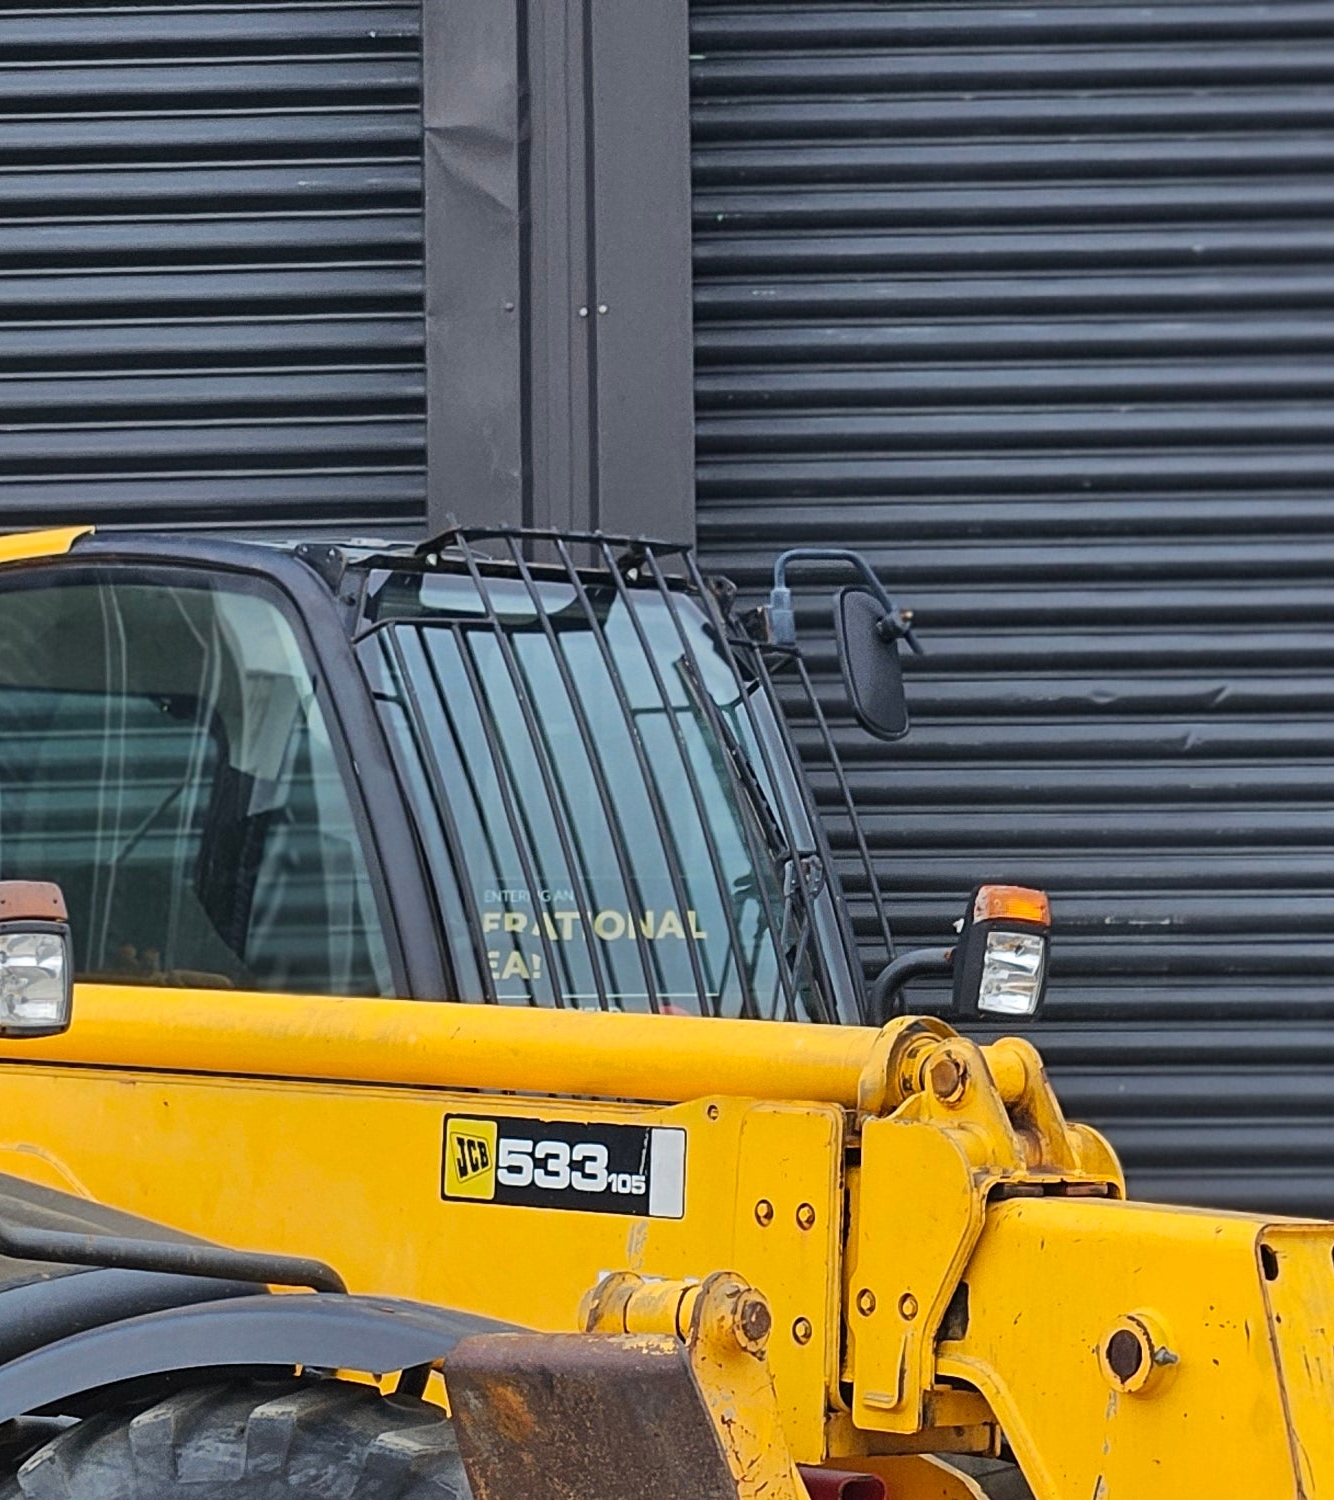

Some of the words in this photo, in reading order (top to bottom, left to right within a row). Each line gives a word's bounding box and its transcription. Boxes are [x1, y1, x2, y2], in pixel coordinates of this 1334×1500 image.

[455, 1136, 490, 1179] JCB
[497, 1138, 608, 1192] 533
[608, 1172, 646, 1195] 105
